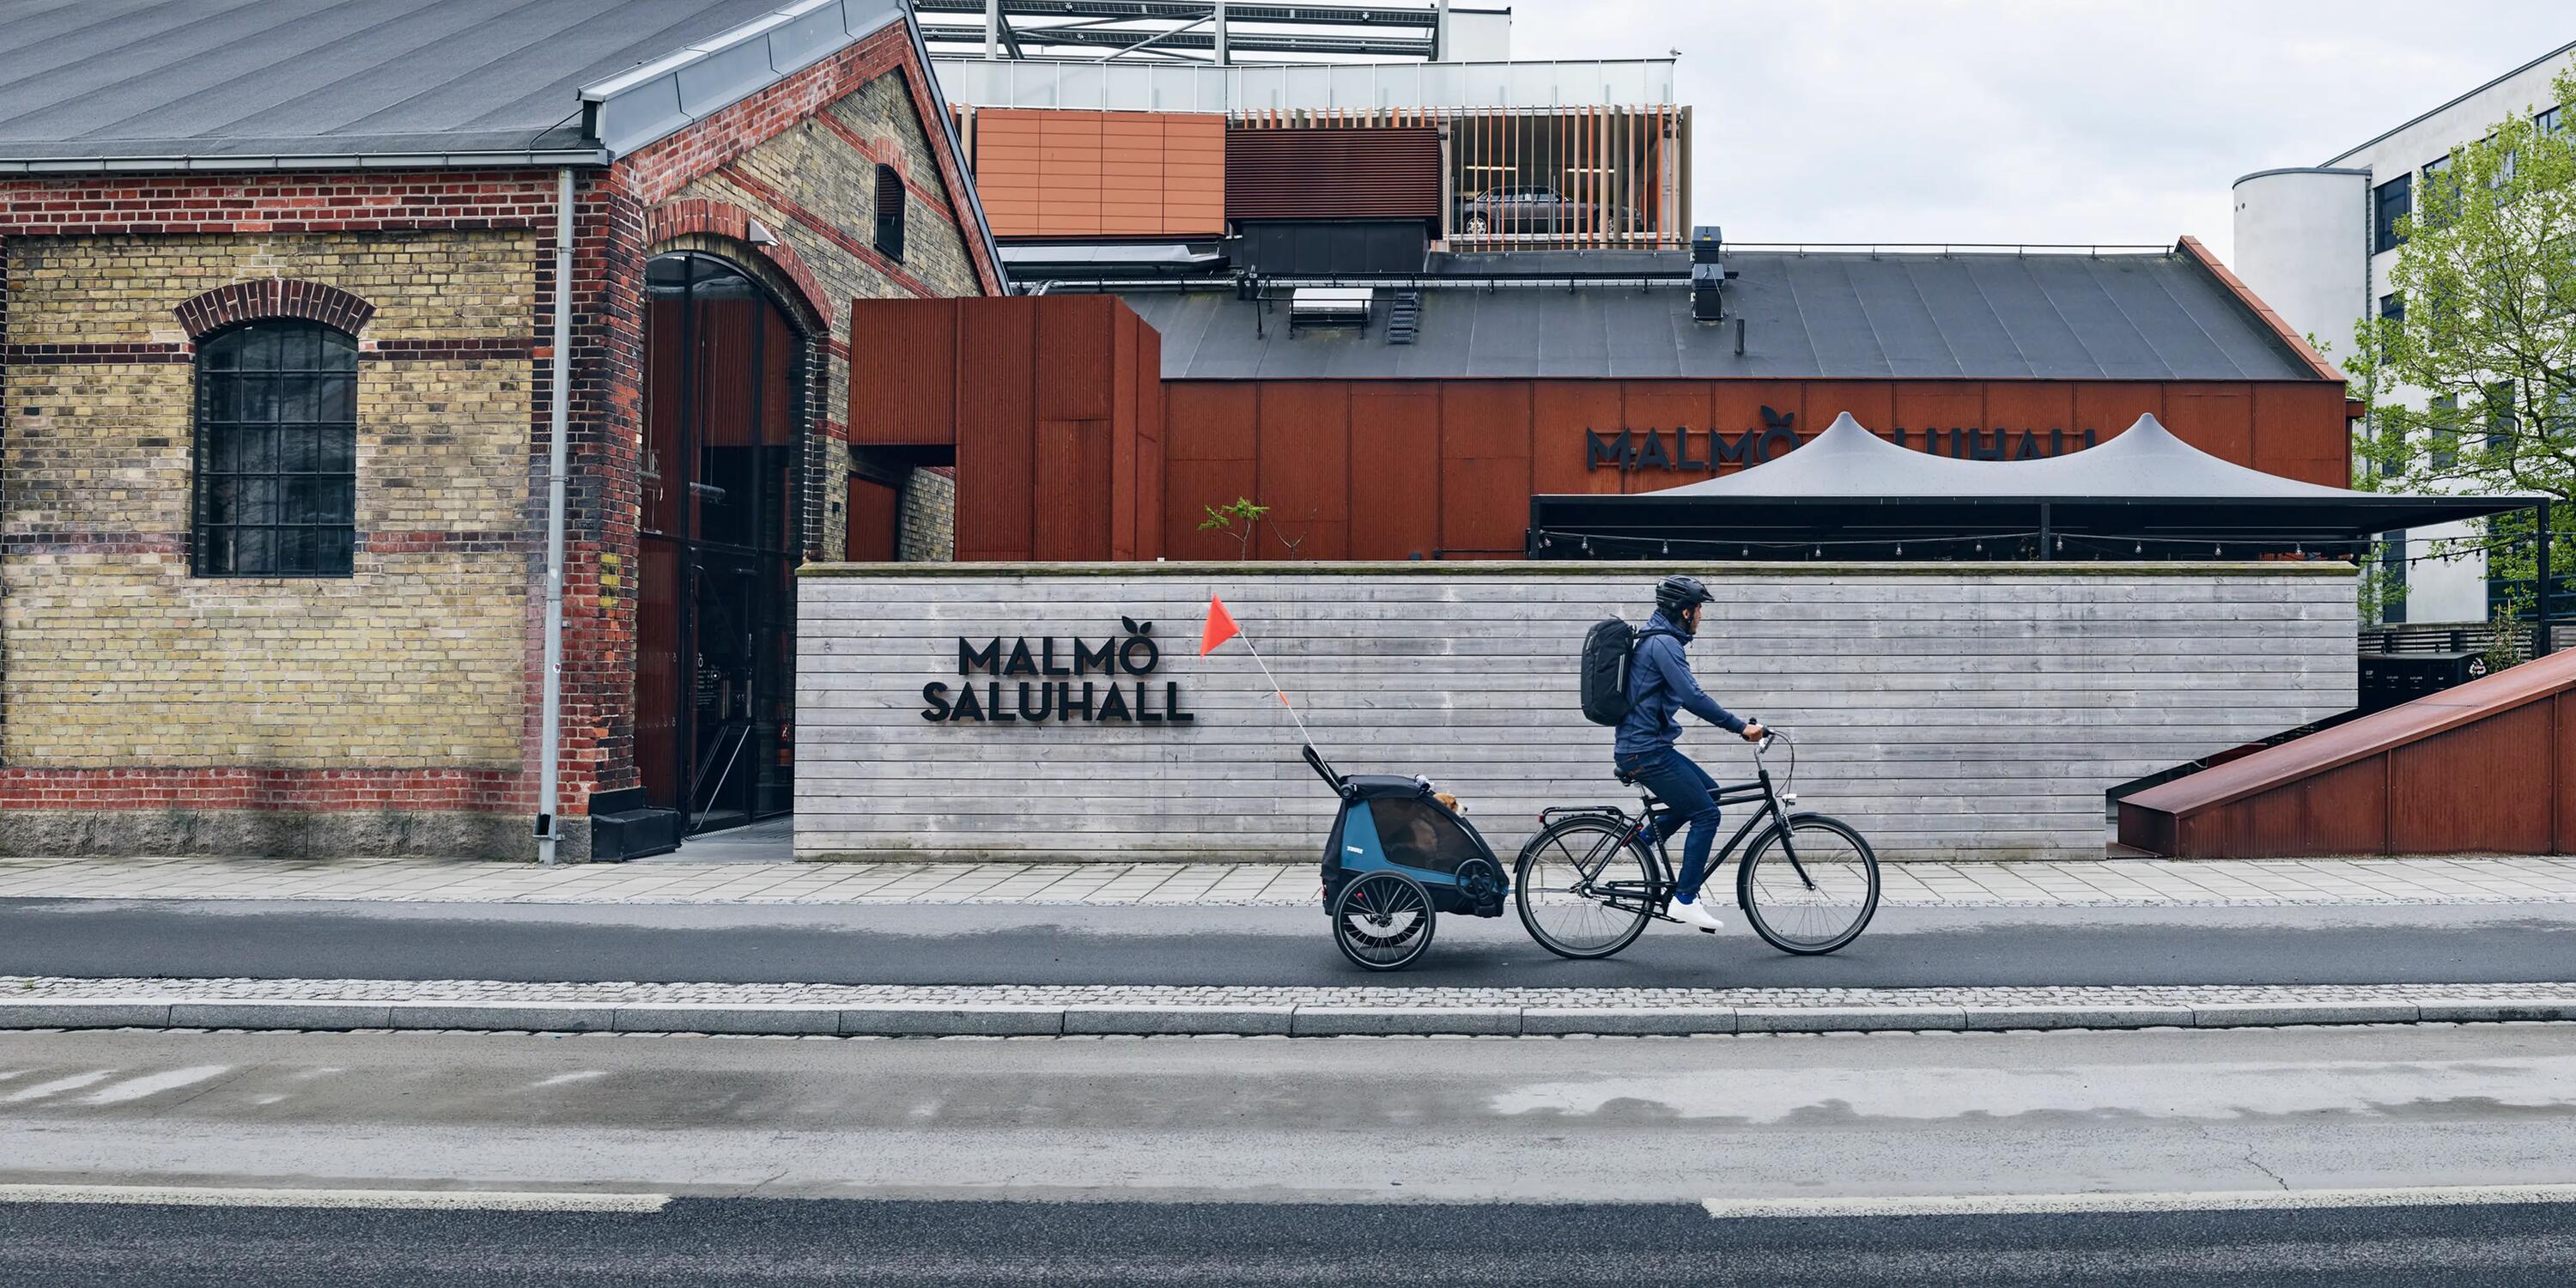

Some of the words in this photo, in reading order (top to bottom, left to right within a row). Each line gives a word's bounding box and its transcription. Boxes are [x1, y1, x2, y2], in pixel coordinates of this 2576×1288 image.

[1586, 405, 1801, 471] MALMÖ
[958, 615, 1159, 676] MALMÖ
[920, 681, 1194, 722] SALUHALL
